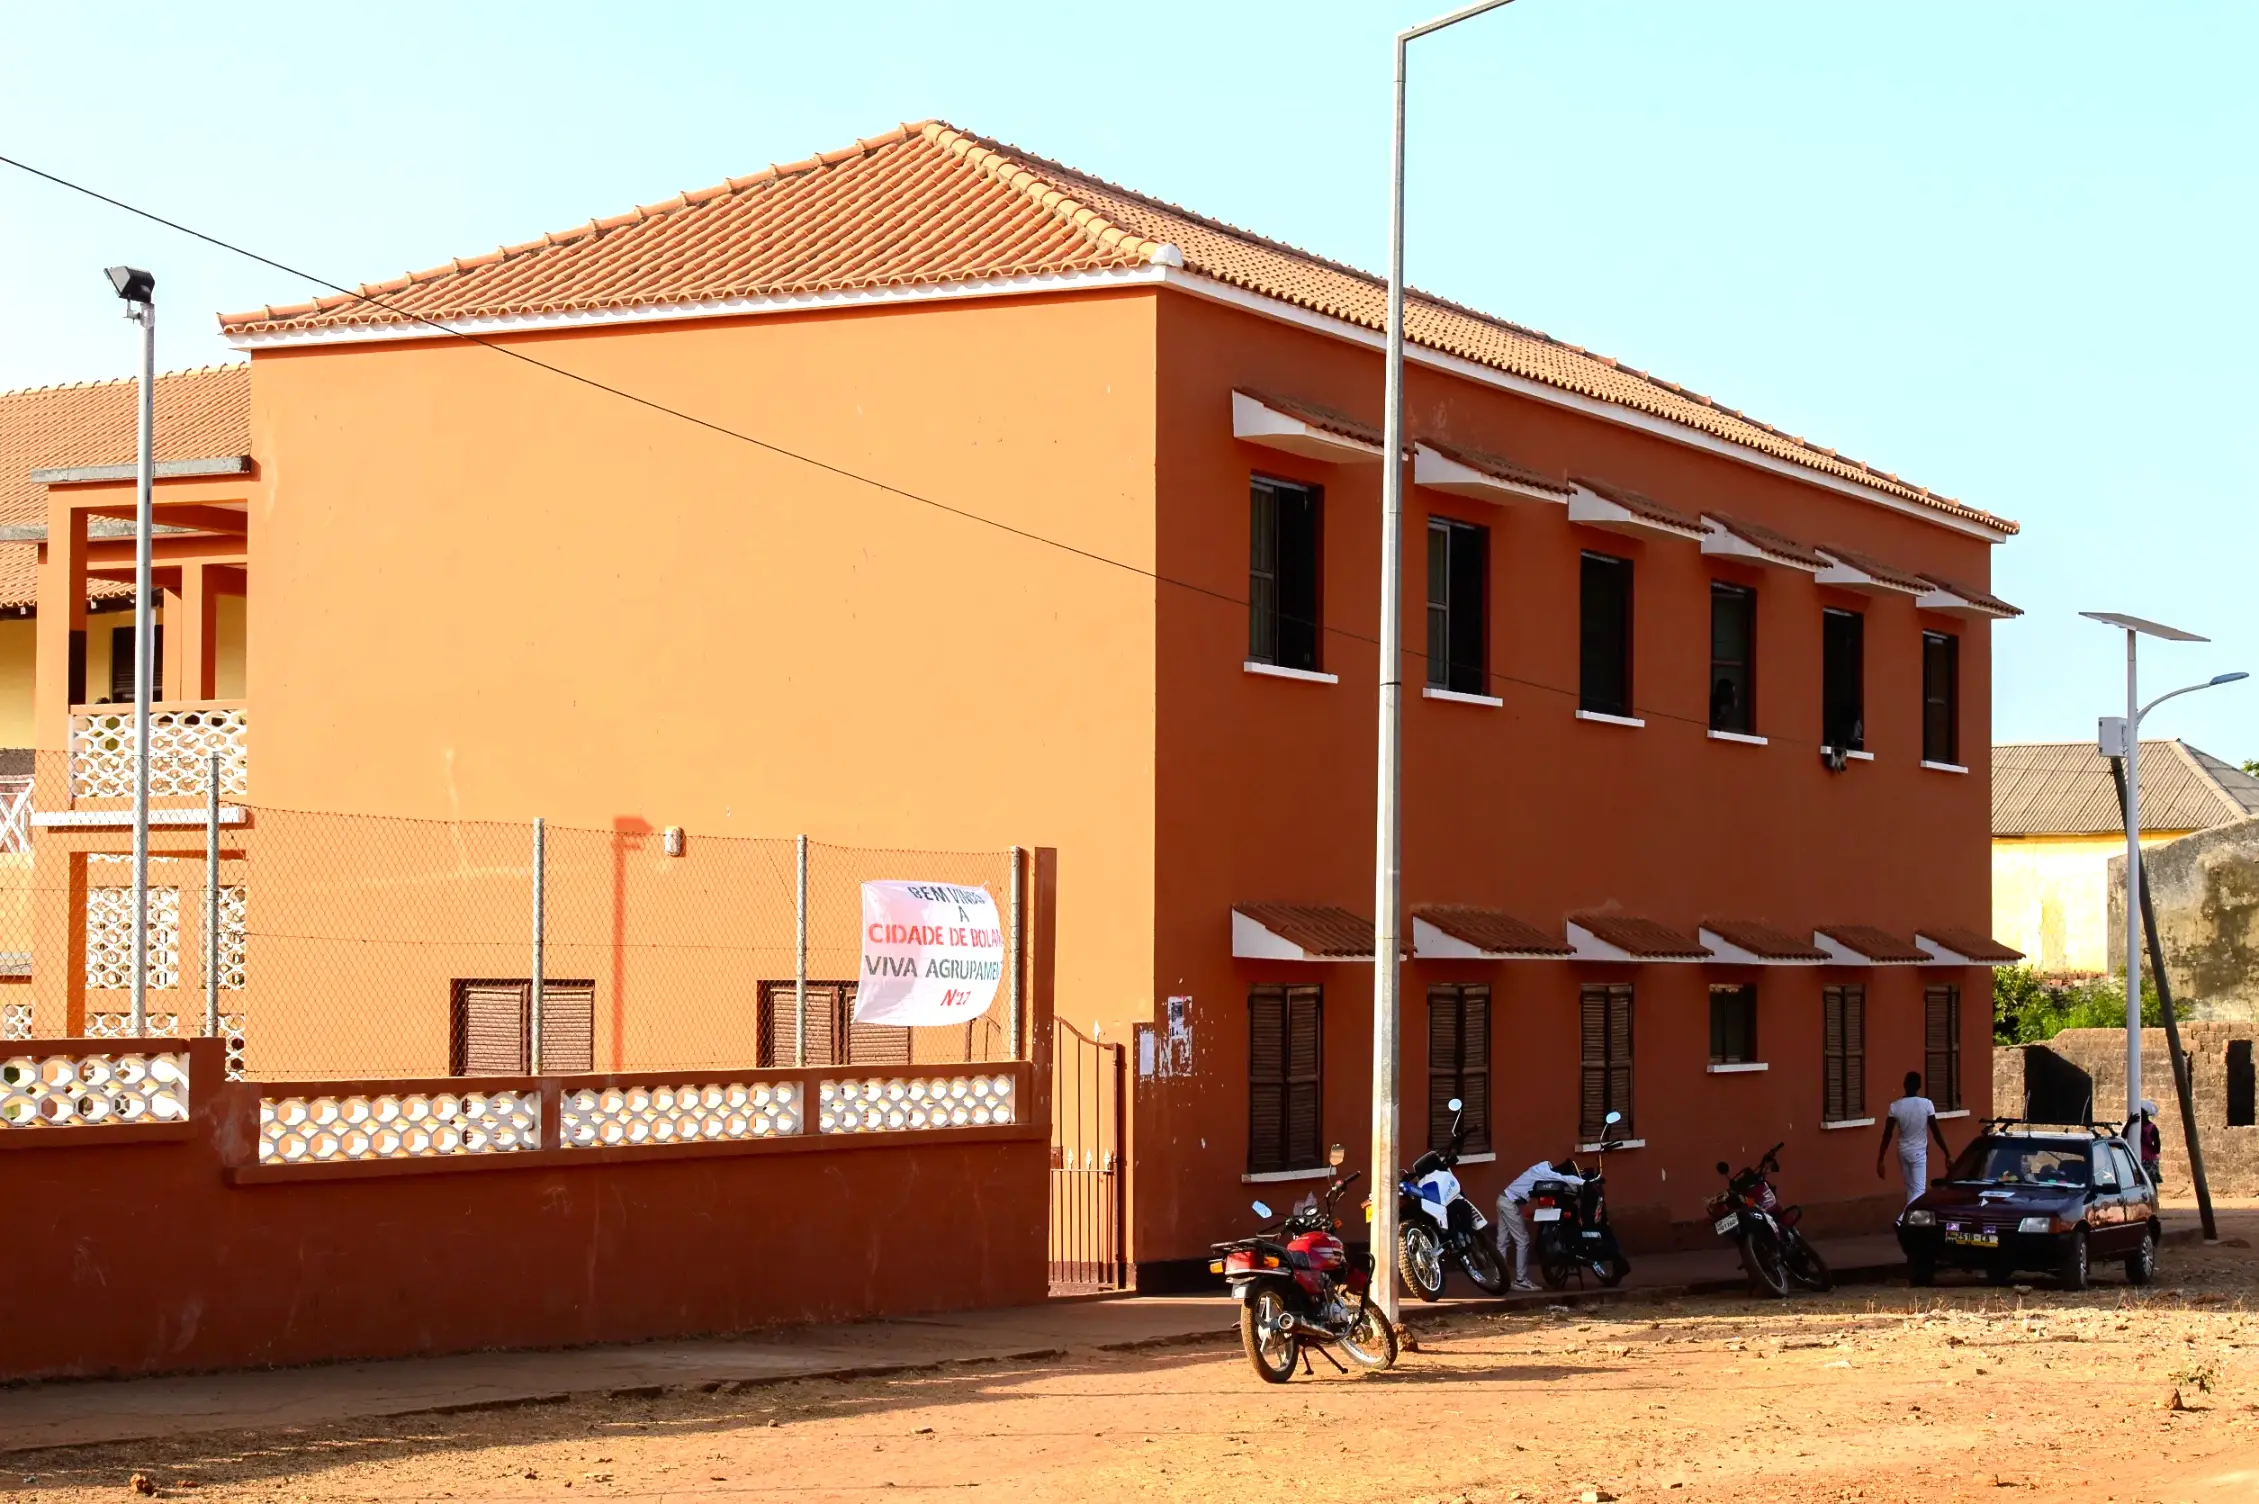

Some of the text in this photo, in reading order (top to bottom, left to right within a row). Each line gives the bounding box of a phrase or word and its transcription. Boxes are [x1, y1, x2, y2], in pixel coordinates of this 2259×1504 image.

[907, 886, 951, 903] BEM
[958, 905, 970, 922] A
[868, 923, 945, 946] CIDADE
[949, 926, 969, 947] DE
[864, 954, 1002, 980] VIVA AGRUPAMEN
